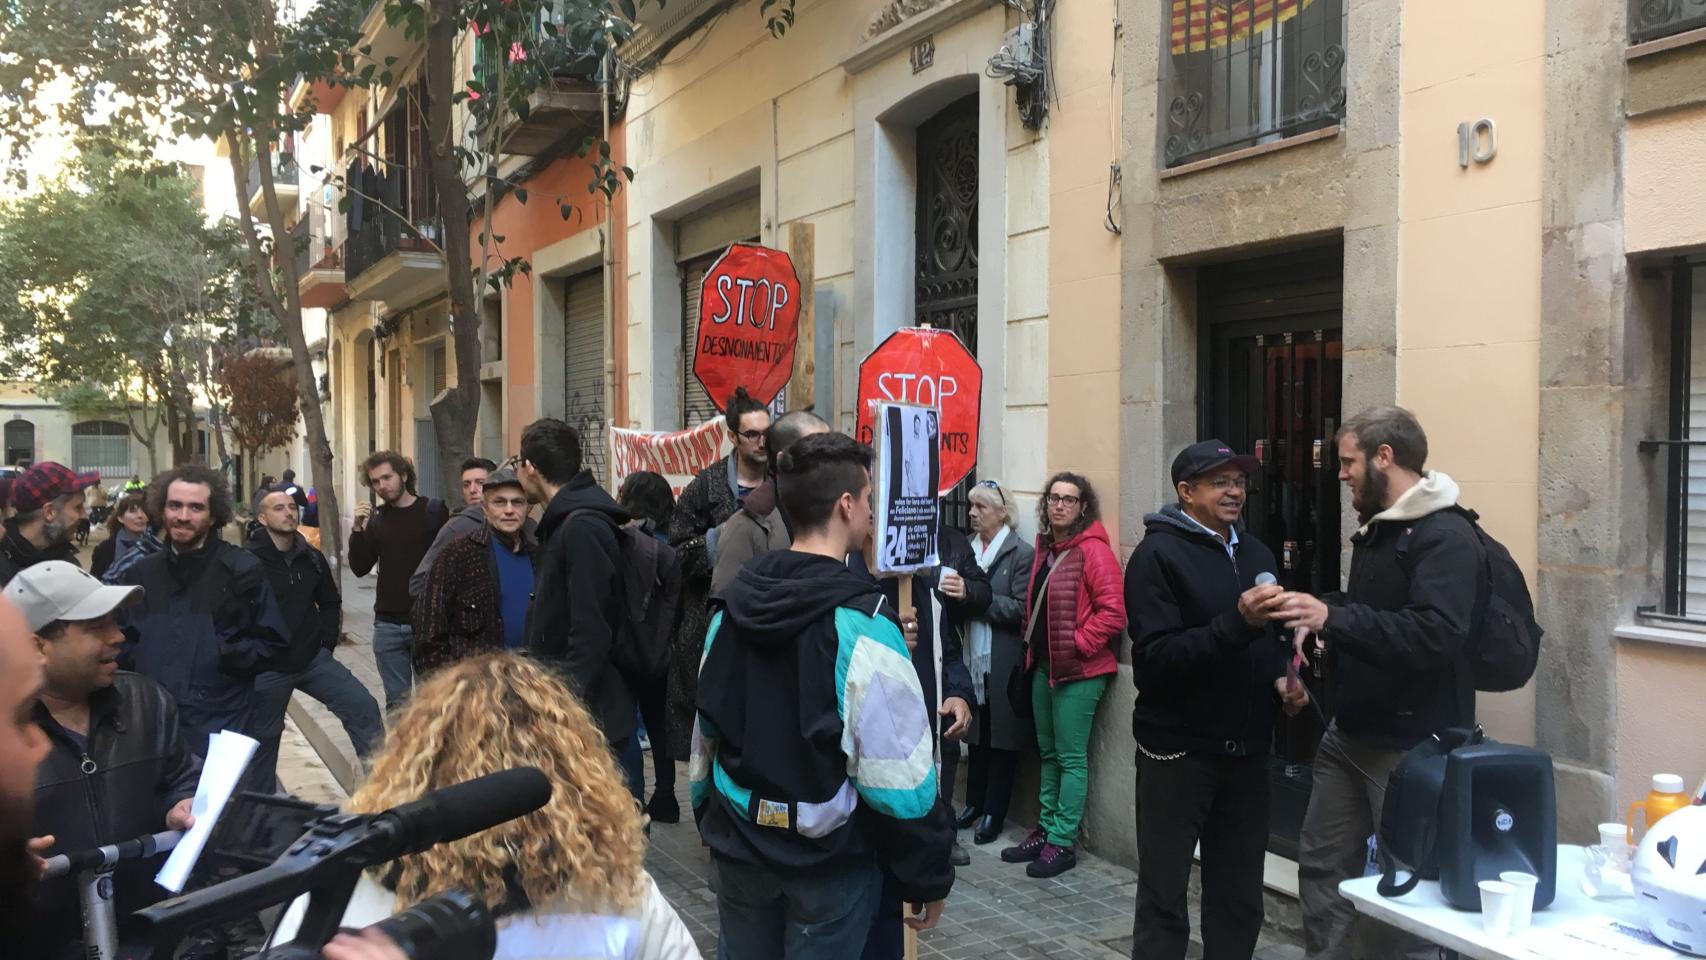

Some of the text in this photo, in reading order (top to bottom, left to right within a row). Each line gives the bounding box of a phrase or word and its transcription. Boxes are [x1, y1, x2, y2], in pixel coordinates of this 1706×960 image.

[913, 40, 931, 69] 12
[1457, 119, 1494, 168] 10
[711, 274, 788, 331] STOP
[878, 372, 958, 417] STOP
[886, 525, 907, 565] 24
